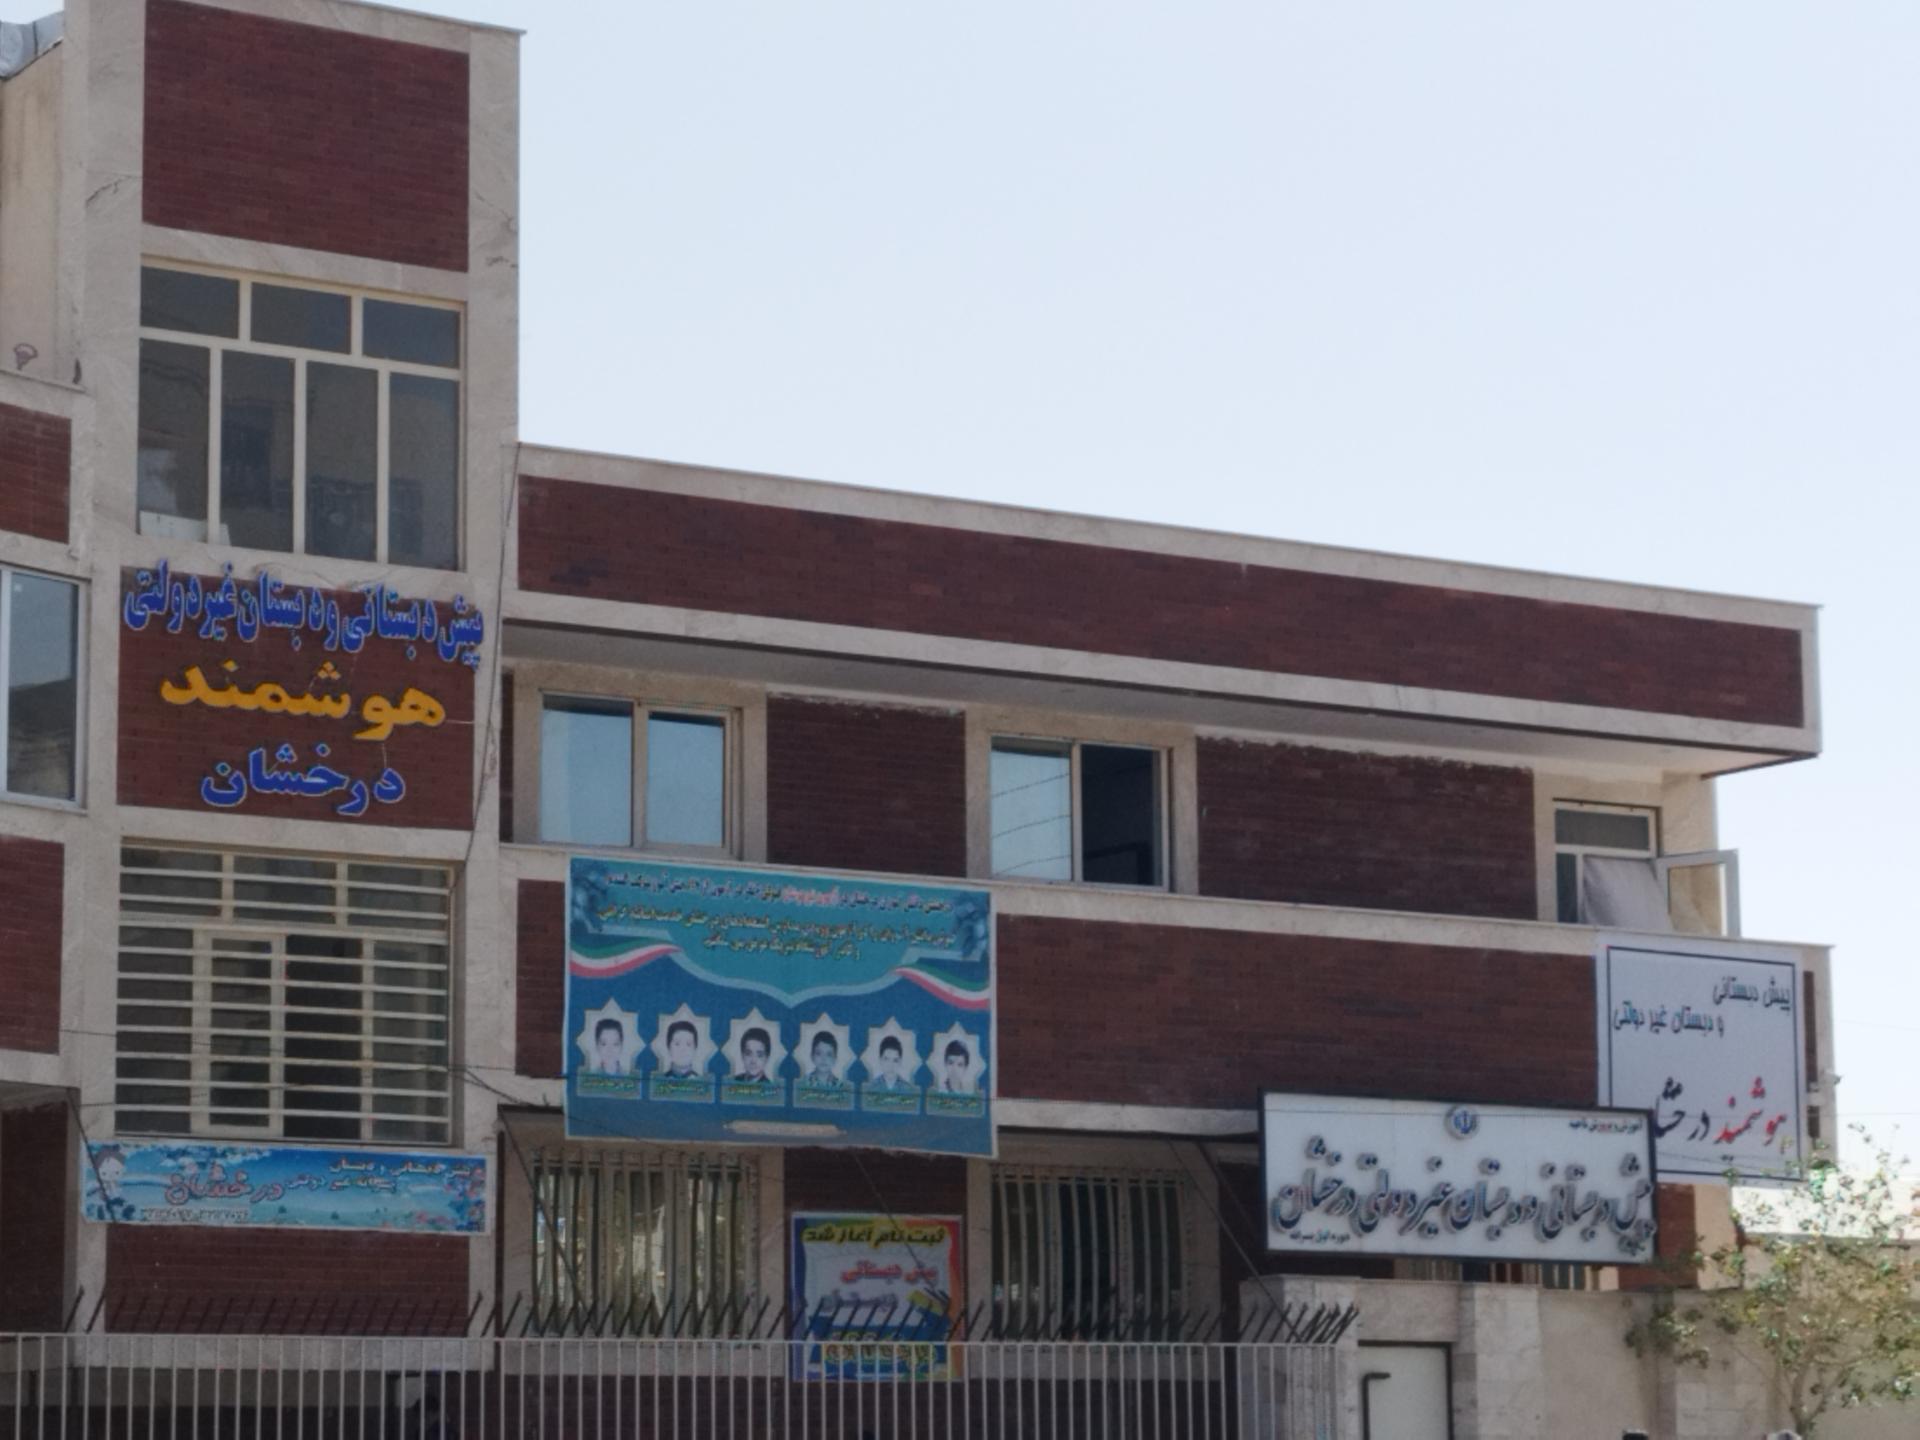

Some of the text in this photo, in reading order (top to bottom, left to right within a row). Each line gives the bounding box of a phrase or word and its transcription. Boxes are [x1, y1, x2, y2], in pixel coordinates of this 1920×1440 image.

[237, 570, 324, 651] دبستان
[342, 584, 438, 660] دبستانی
[437, 595, 484, 671] پیش
[160, 658, 446, 740] هوشمند
[200, 743, 405, 816] درخشان
[1614, 1000, 1646, 1031] دولتی
[1650, 1004, 1667, 1034] غیر
[1671, 1005, 1714, 1036] دبستان
[1713, 976, 1791, 1012] پیش دبستانی
[1654, 1077, 1710, 1141] درخشا
[1271, 1135, 1356, 1232] درخشان
[1442, 1158, 1520, 1242] دبستان
[1535, 1163, 1611, 1242] دبستانی
